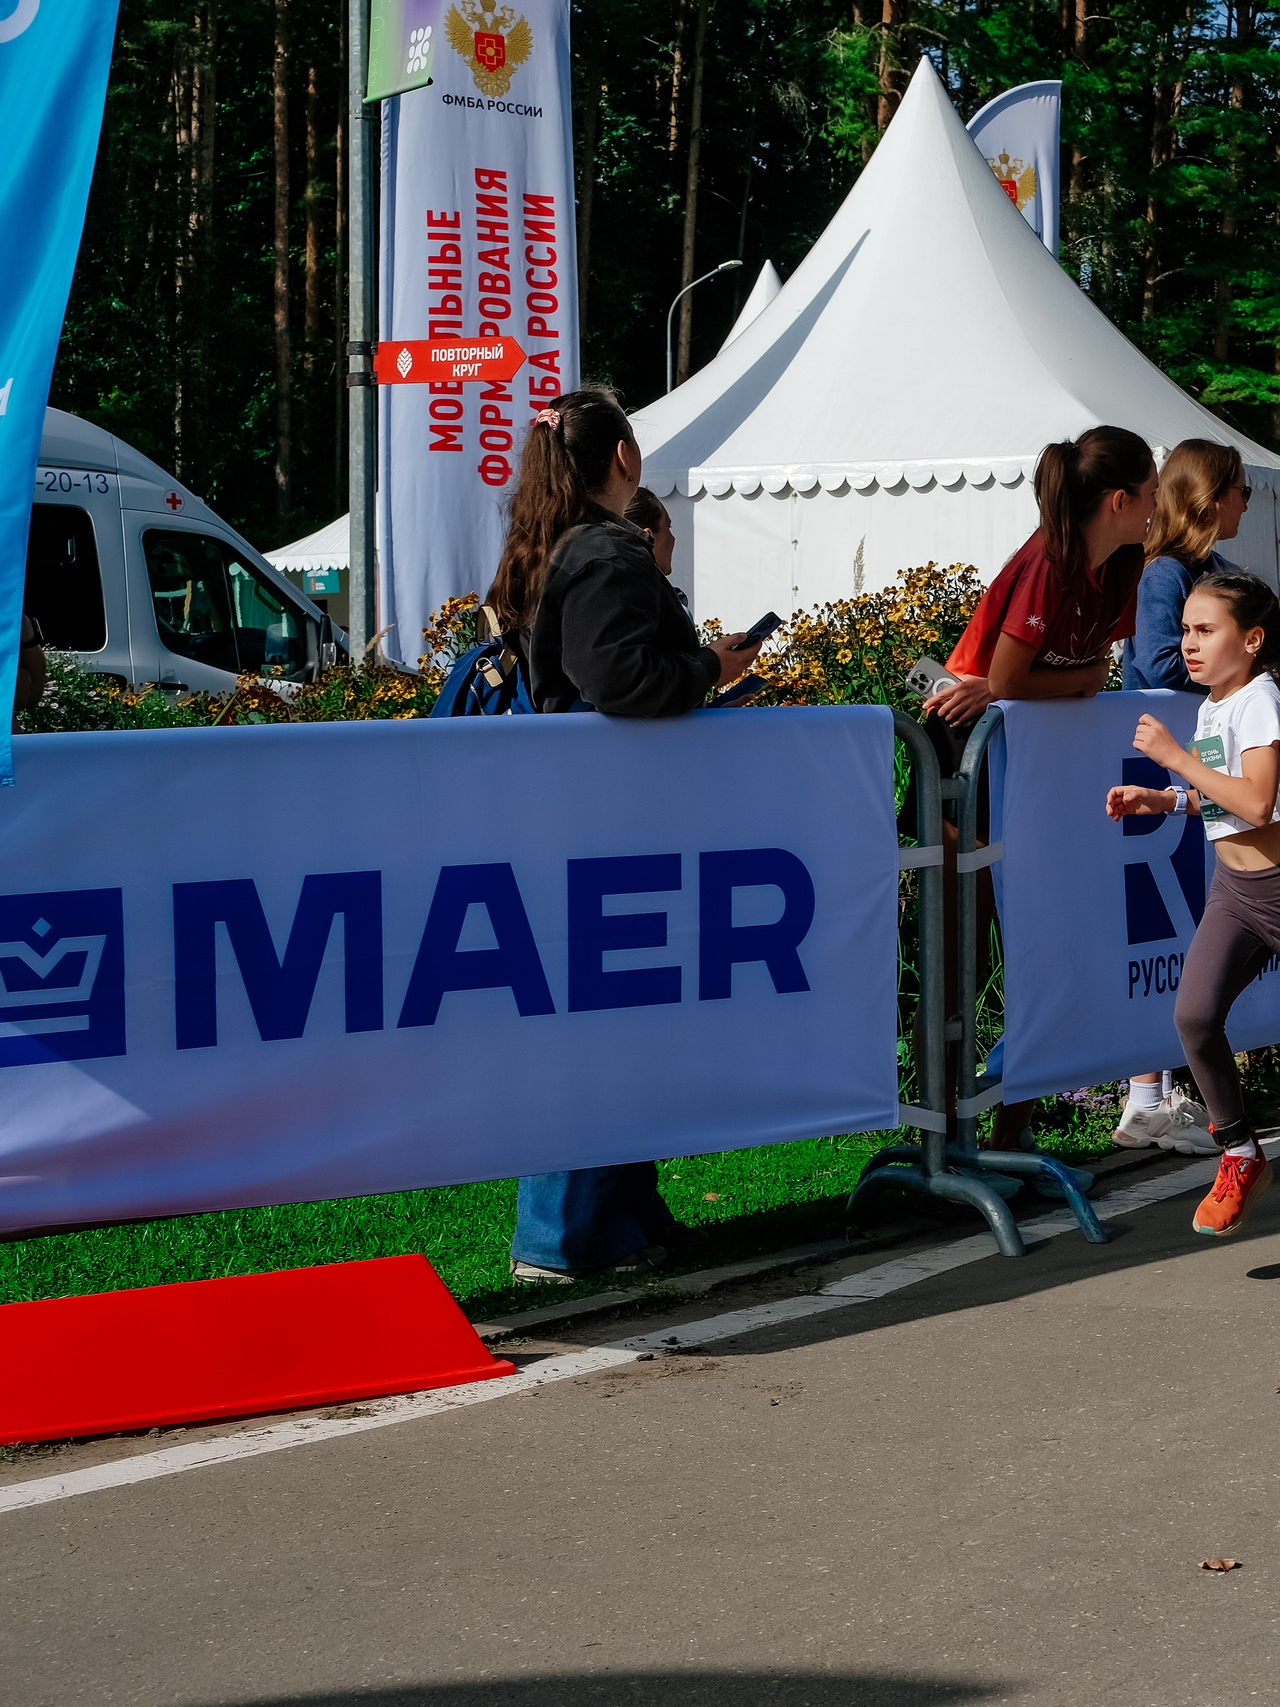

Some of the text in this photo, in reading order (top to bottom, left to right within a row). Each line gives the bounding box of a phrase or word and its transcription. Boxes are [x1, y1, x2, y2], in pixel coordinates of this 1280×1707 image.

[442, 94, 543, 118] ФМБА РОССИИ
[426, 209, 463, 452] МОБЛЬНЫЕ
[474, 167, 513, 487] ФОРМРОВАНИЯ
[522, 193, 561, 426] БА РОССИИ
[431, 343, 504, 362] ПОВТОРНЫЙ
[452, 363, 482, 377] КРУГ
[35, 471, 109, 494] -20-13
[173, 847, 816, 1050] MAER
[1128, 952, 1184, 1000] РУСС
